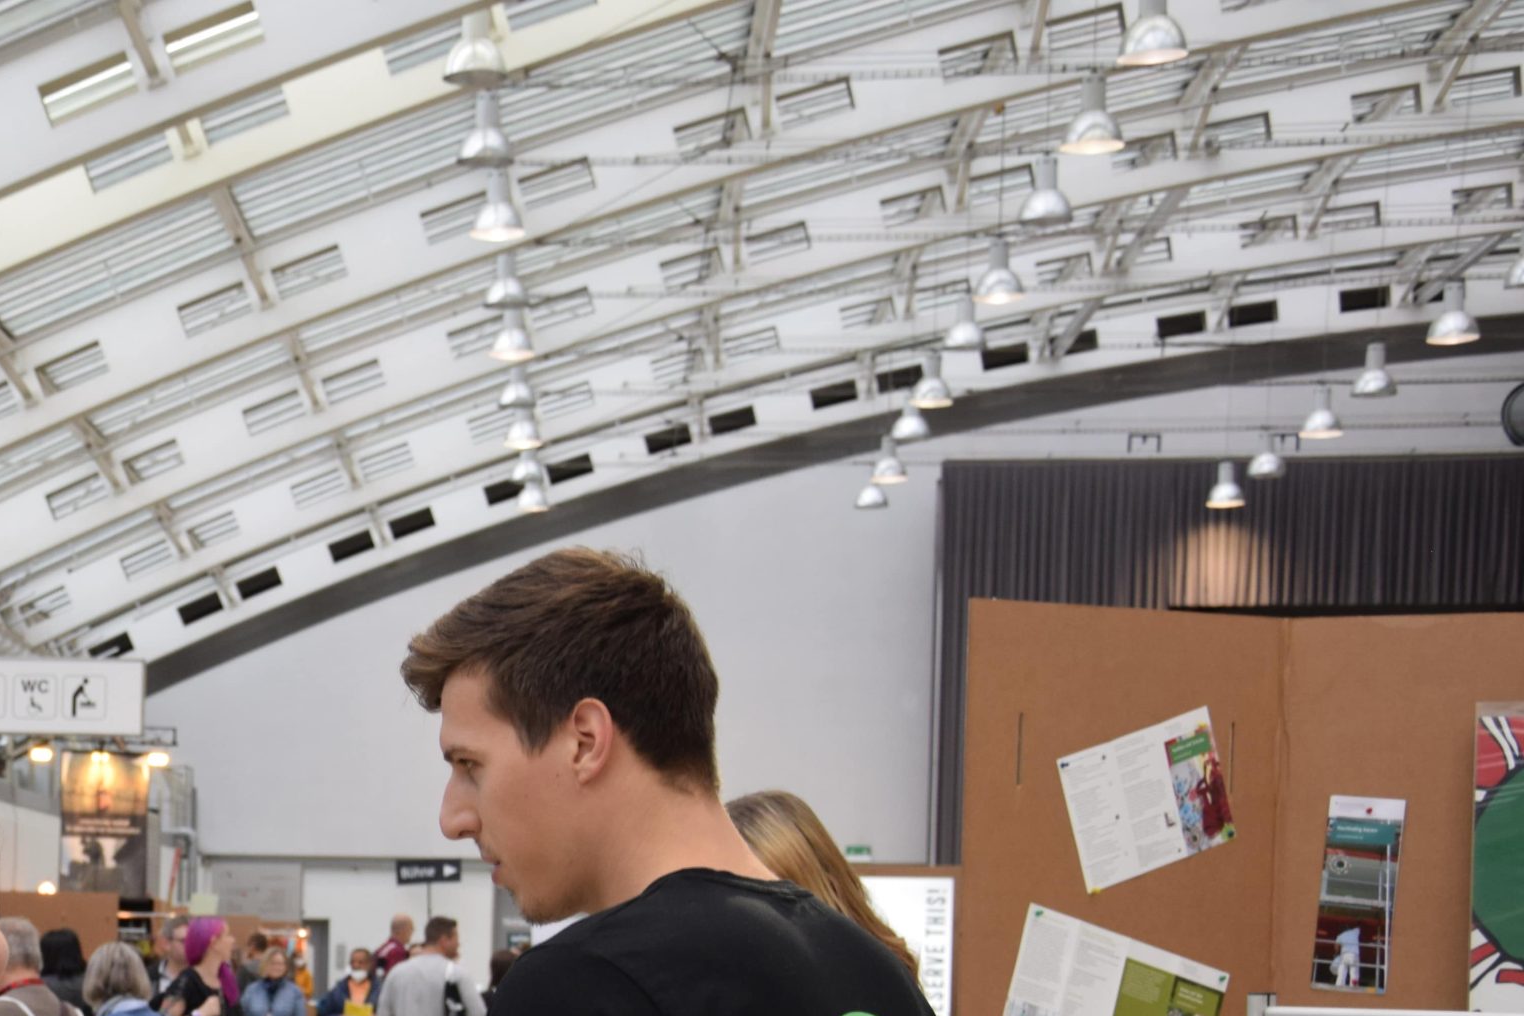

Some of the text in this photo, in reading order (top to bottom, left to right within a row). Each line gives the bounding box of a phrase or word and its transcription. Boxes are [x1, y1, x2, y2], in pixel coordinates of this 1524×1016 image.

[21, 680, 49, 692] WC
[399, 865, 436, 880] Bühne
[925, 888, 947, 937] THIS!
